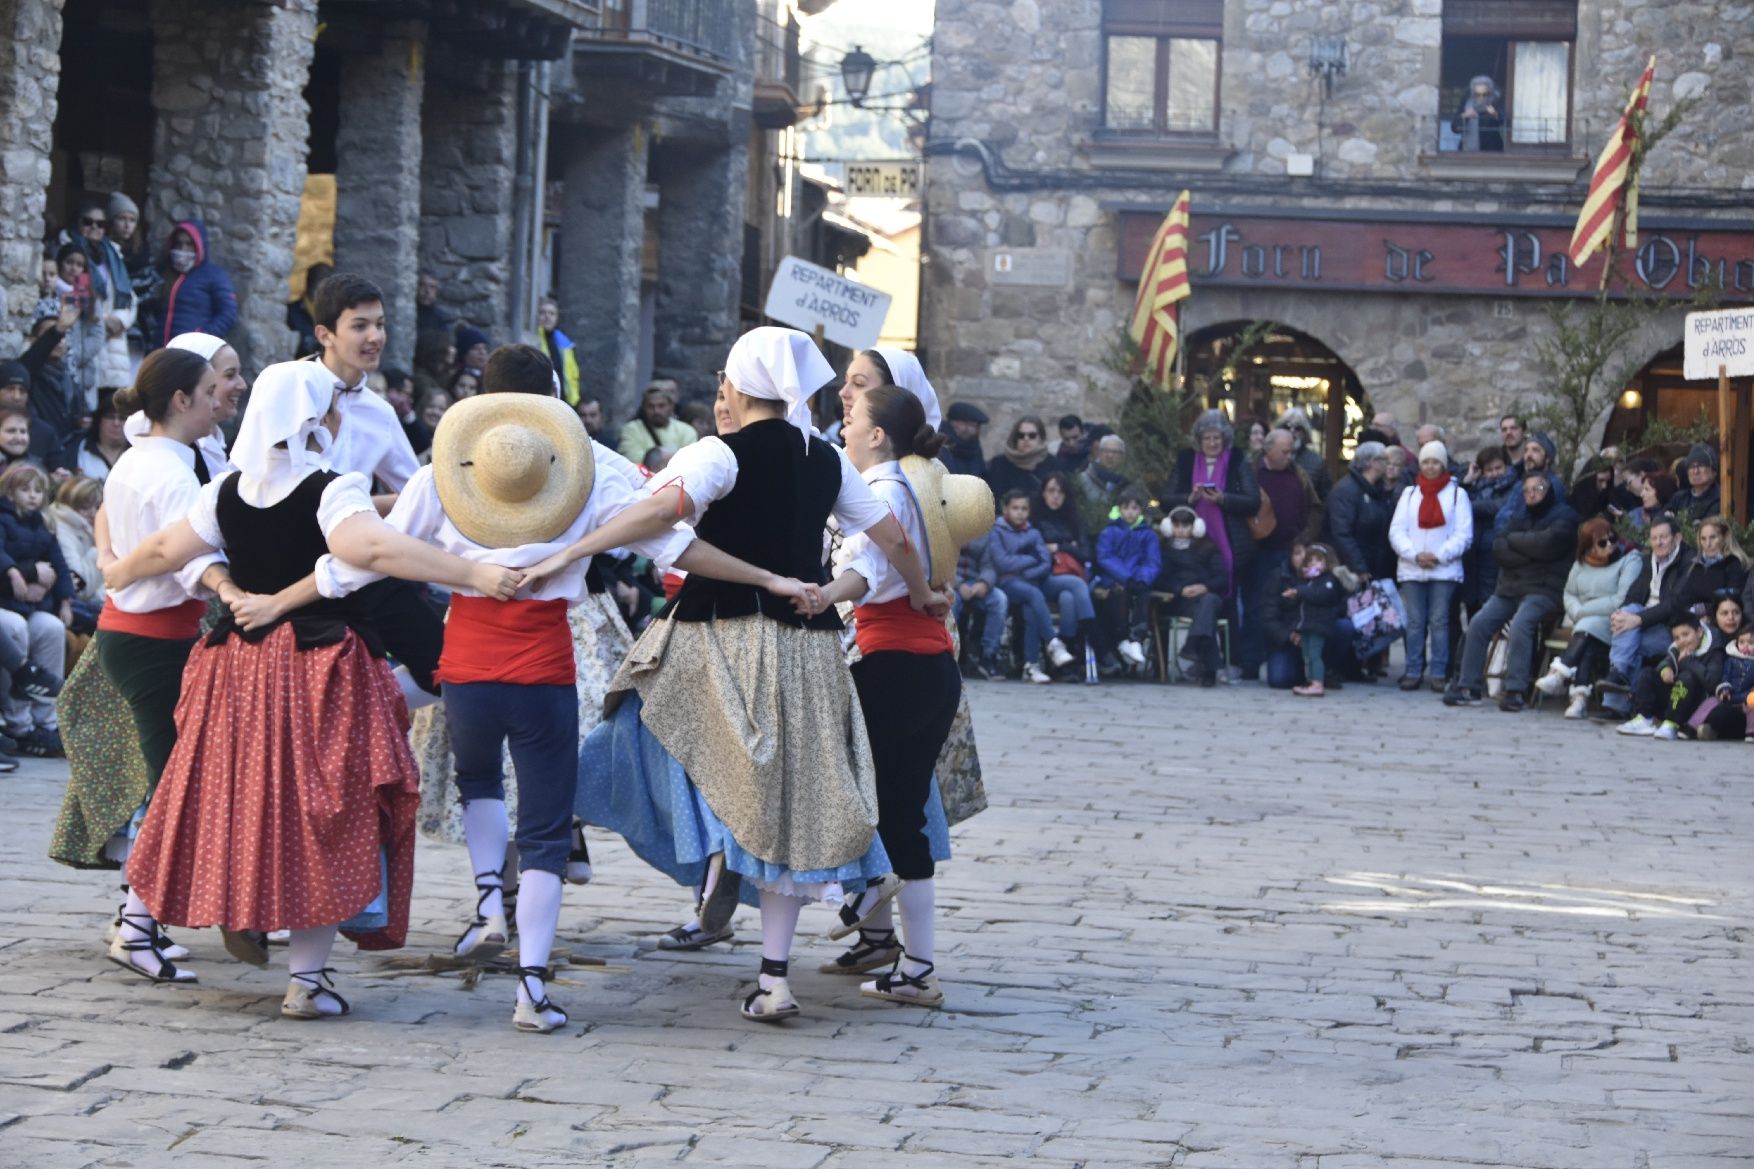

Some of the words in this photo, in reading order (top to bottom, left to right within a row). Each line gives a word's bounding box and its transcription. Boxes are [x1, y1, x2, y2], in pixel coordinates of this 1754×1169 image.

[848, 167, 879, 193] FORN
[1193, 223, 1322, 281] Forn
[1382, 239, 1435, 282] de
[1495, 230, 1569, 287] Pa
